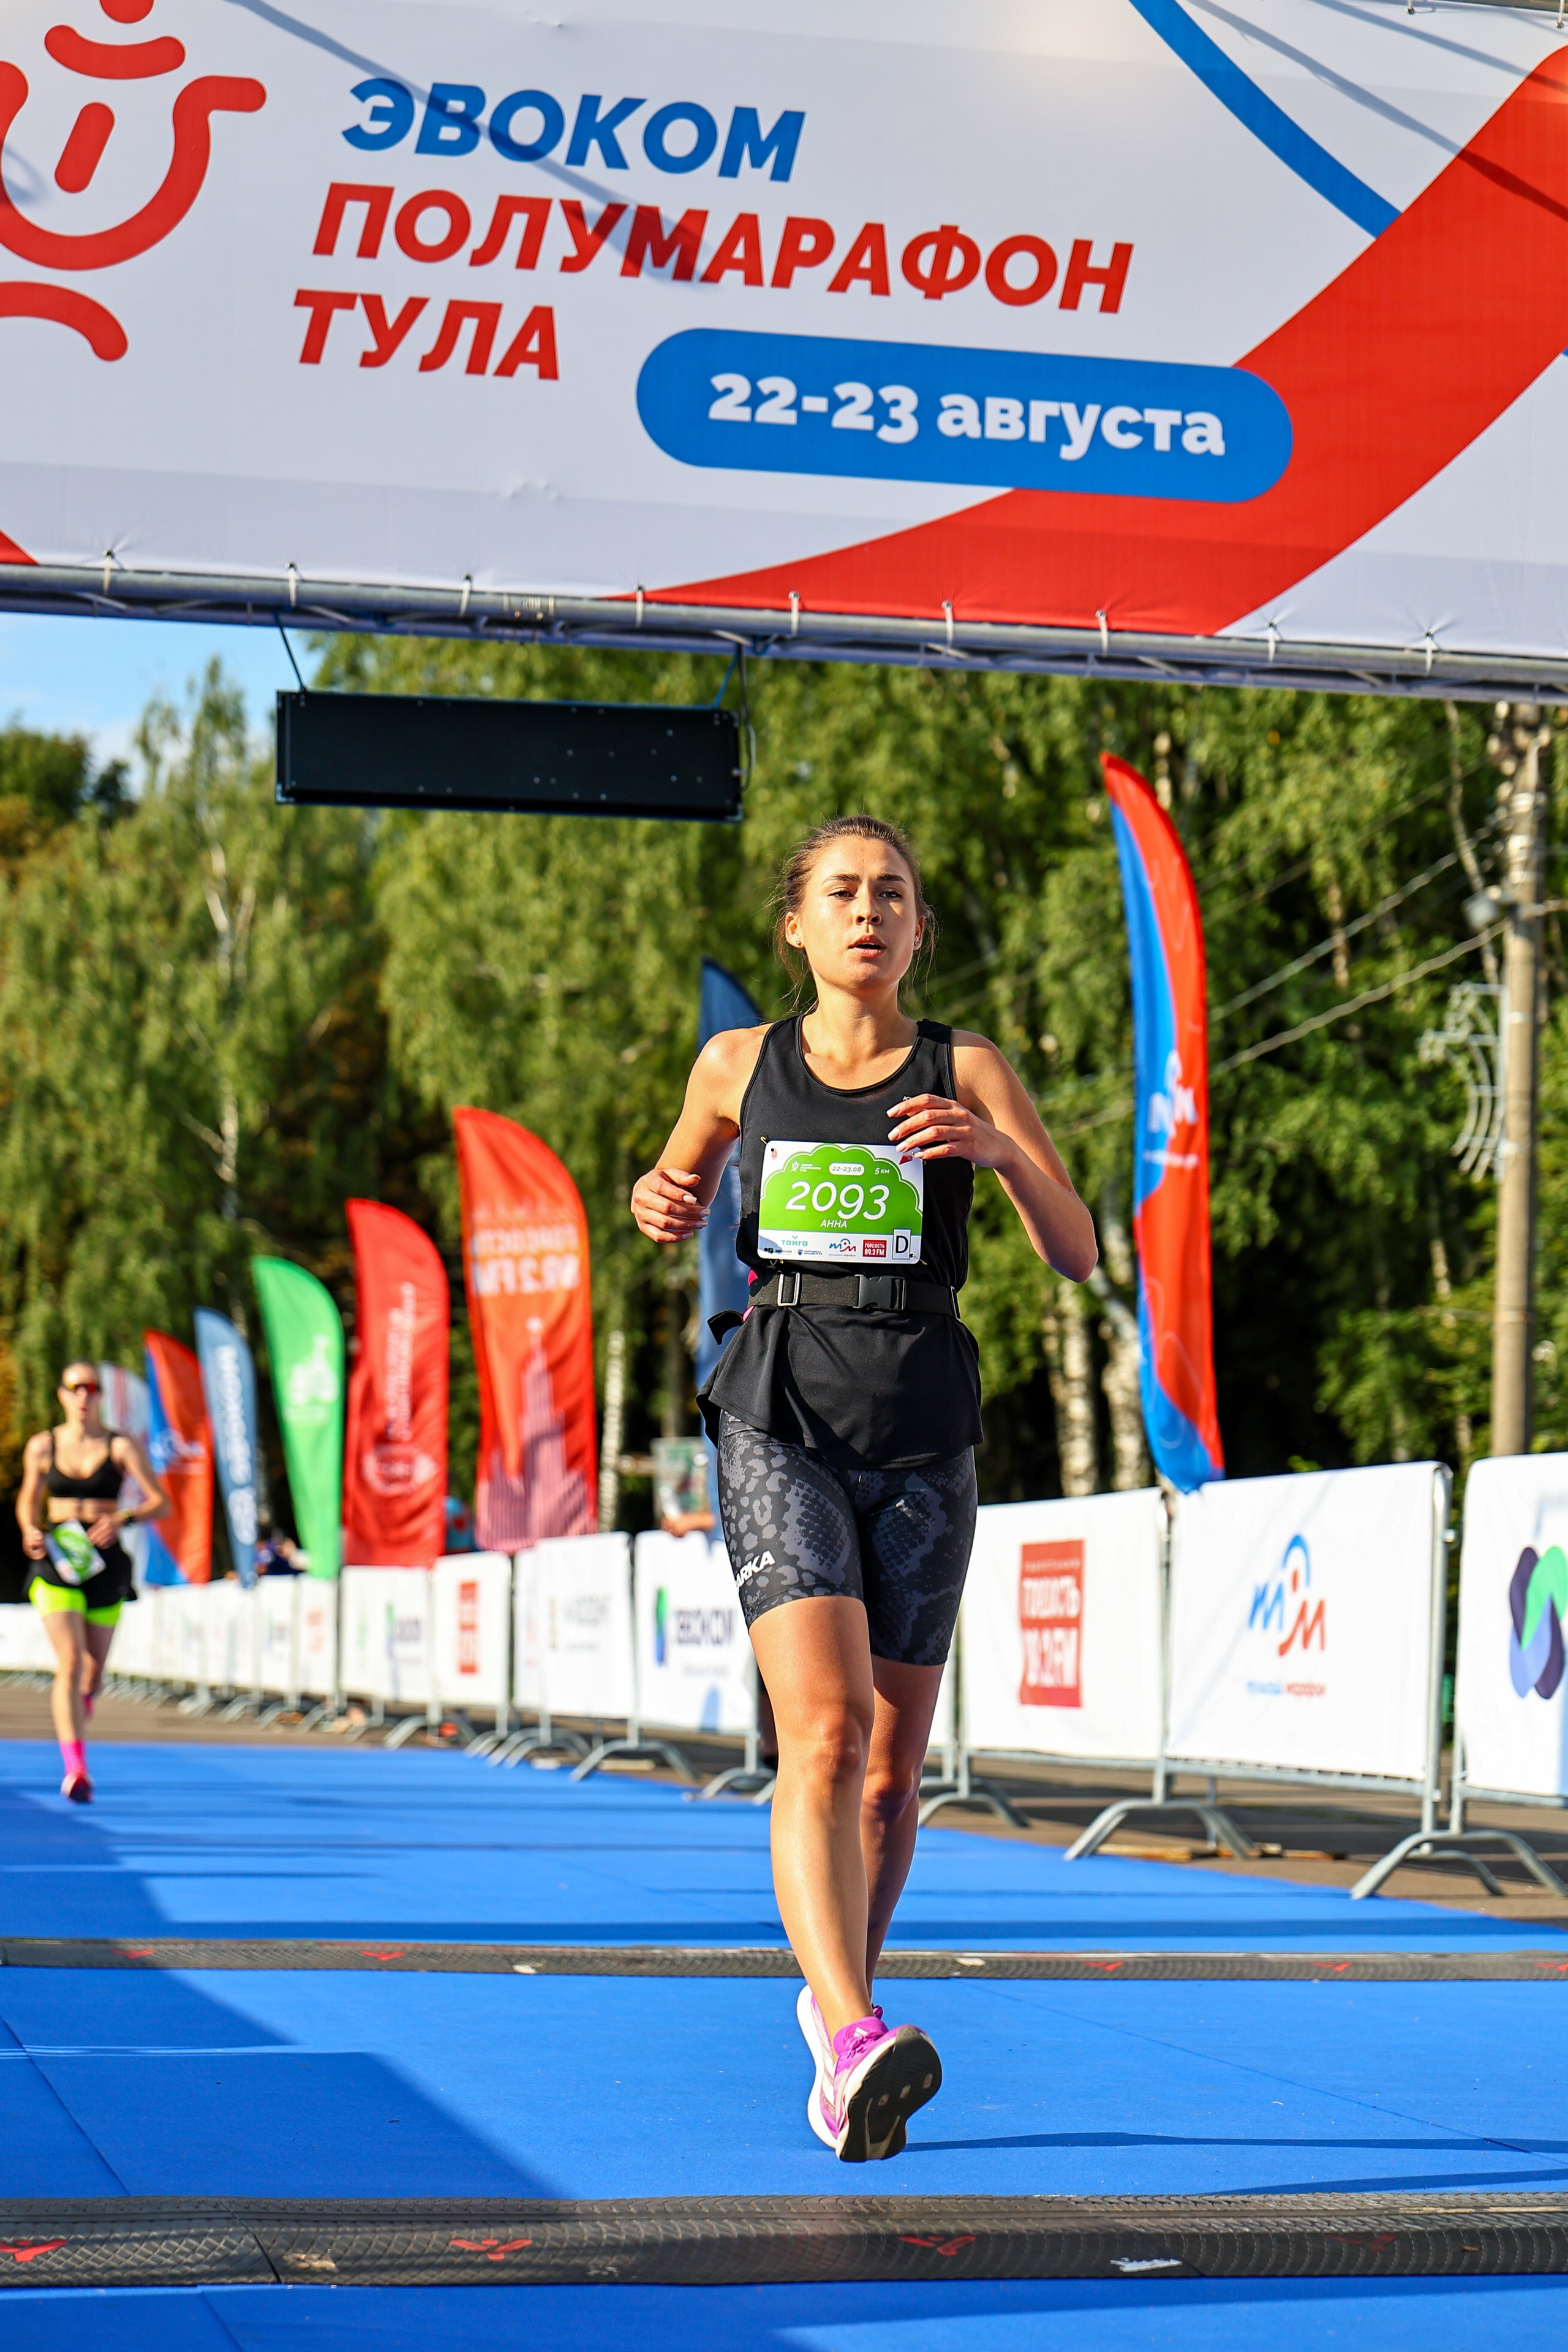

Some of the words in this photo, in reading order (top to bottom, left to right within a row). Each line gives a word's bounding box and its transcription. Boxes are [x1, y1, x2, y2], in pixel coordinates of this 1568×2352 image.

[341, 77, 806, 184] ЭВОКОМ
[312, 181, 1134, 315] ПОЛУМАРАФОН
[293, 289, 561, 382] ТУЛА
[708, 372, 920, 446] 22-23
[937, 392, 1226, 462] августа
[785, 1181, 890, 1220] 2093
[781, 1235, 809, 1246] тайга
[820, 1219, 848, 1229] АННА
[895, 1235, 909, 1254] D
[734, 1550, 775, 1593] ARKA
